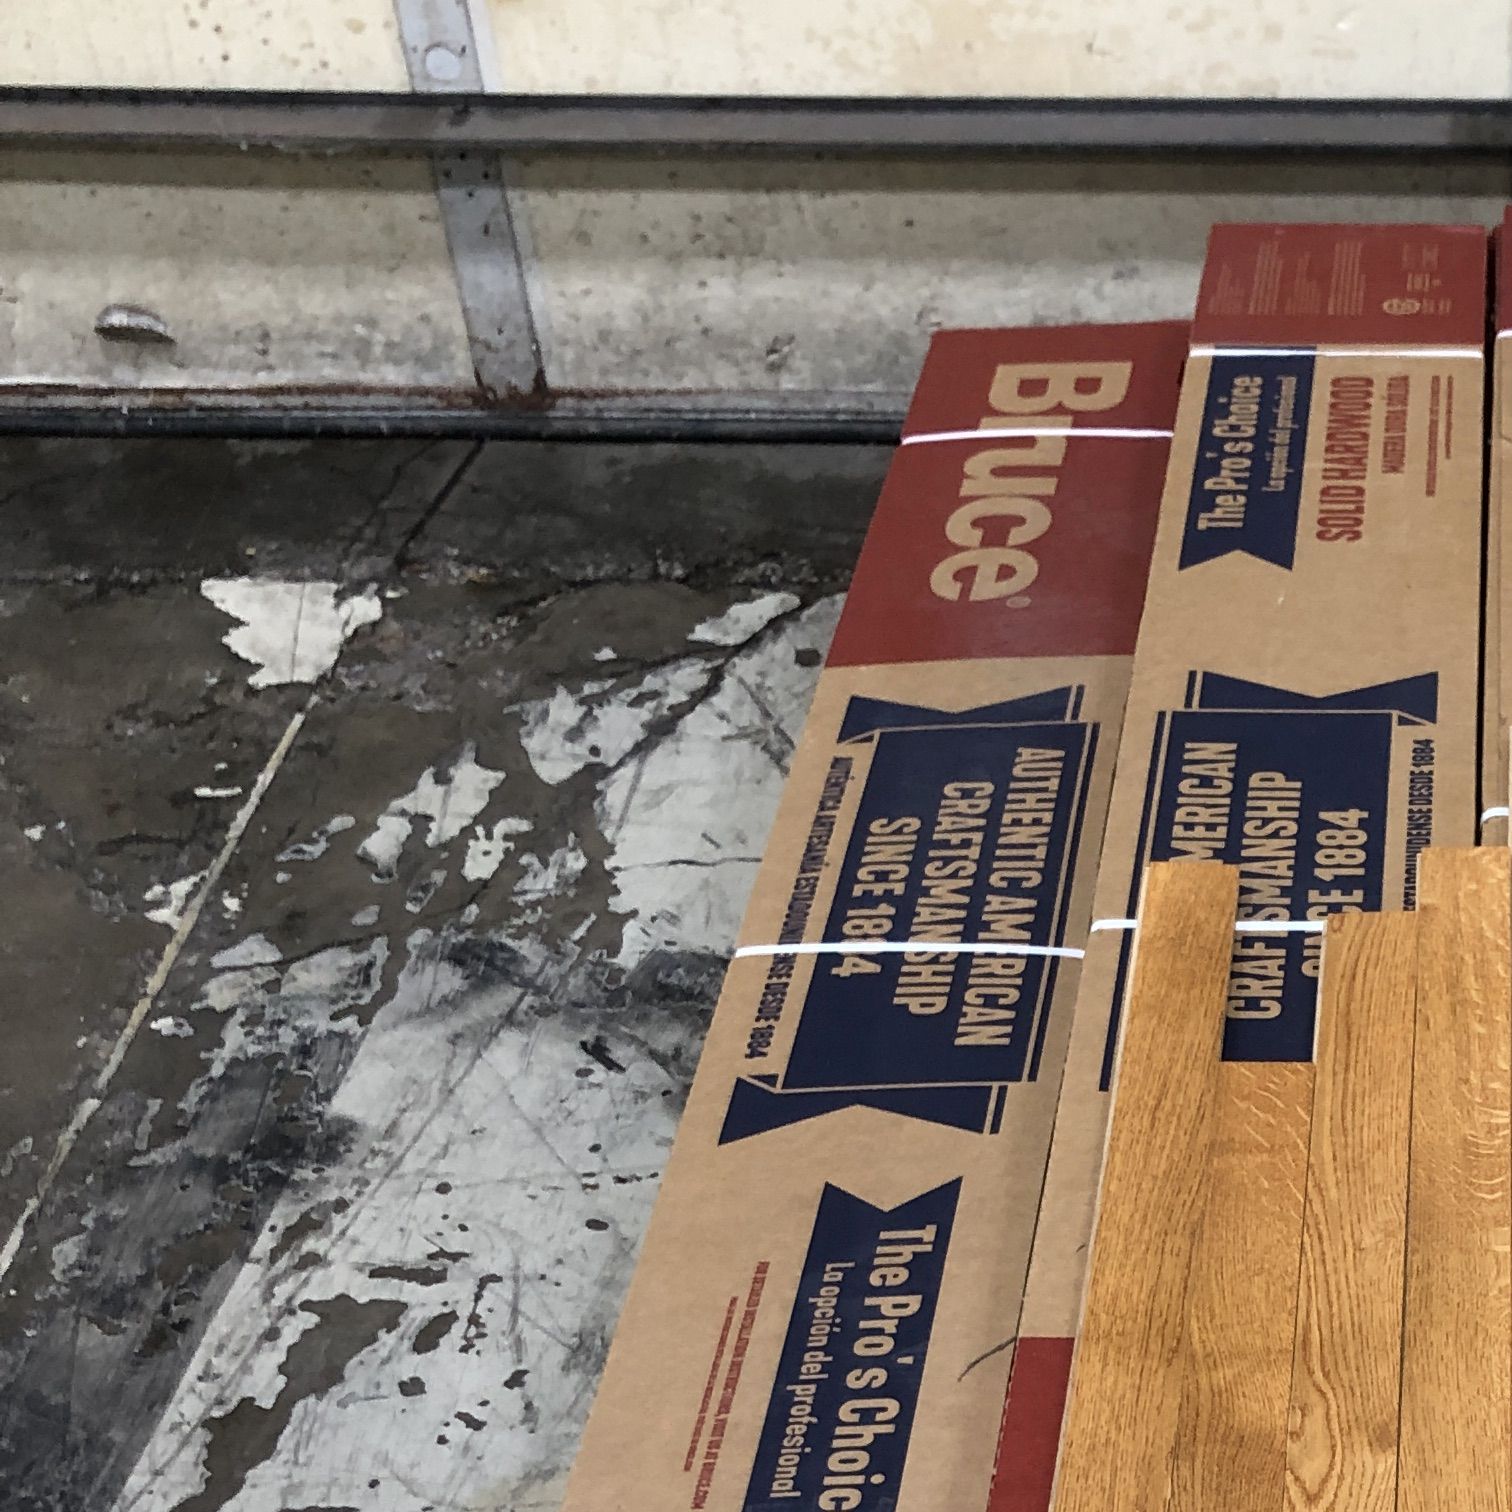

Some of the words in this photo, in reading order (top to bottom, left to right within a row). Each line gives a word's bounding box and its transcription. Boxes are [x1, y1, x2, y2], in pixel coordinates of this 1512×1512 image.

[1212, 375, 1263, 438] Choice
[1321, 376, 1374, 481] HARDWOOD
[929, 361, 1133, 601] Bruce
[1204, 441, 1254, 491] Pro's
[1197, 494, 1247, 531] The
[1315, 485, 1365, 542] SOLID
[1408, 769, 1434, 805] DESDE
[1411, 738, 1435, 767] 1884
[988, 745, 1066, 890] AUTHENTIC
[1168, 741, 1238, 864] MERICAN
[852, 816, 922, 898] SINCE
[1313, 808, 1370, 882] 1884
[893, 781, 995, 1016] CRAFTSMANSHIP
[1226, 771, 1303, 1020] CRAFTSMANSHIP
[954, 894, 1038, 1047] AMERICAN
[822, 1261, 855, 1284] La
[868, 1224, 937, 1287] The
[807, 1285, 842, 1348] opción
[846, 1294, 923, 1390] Pro's
[801, 1350, 833, 1381] del
[769, 1383, 819, 1499] profesional
